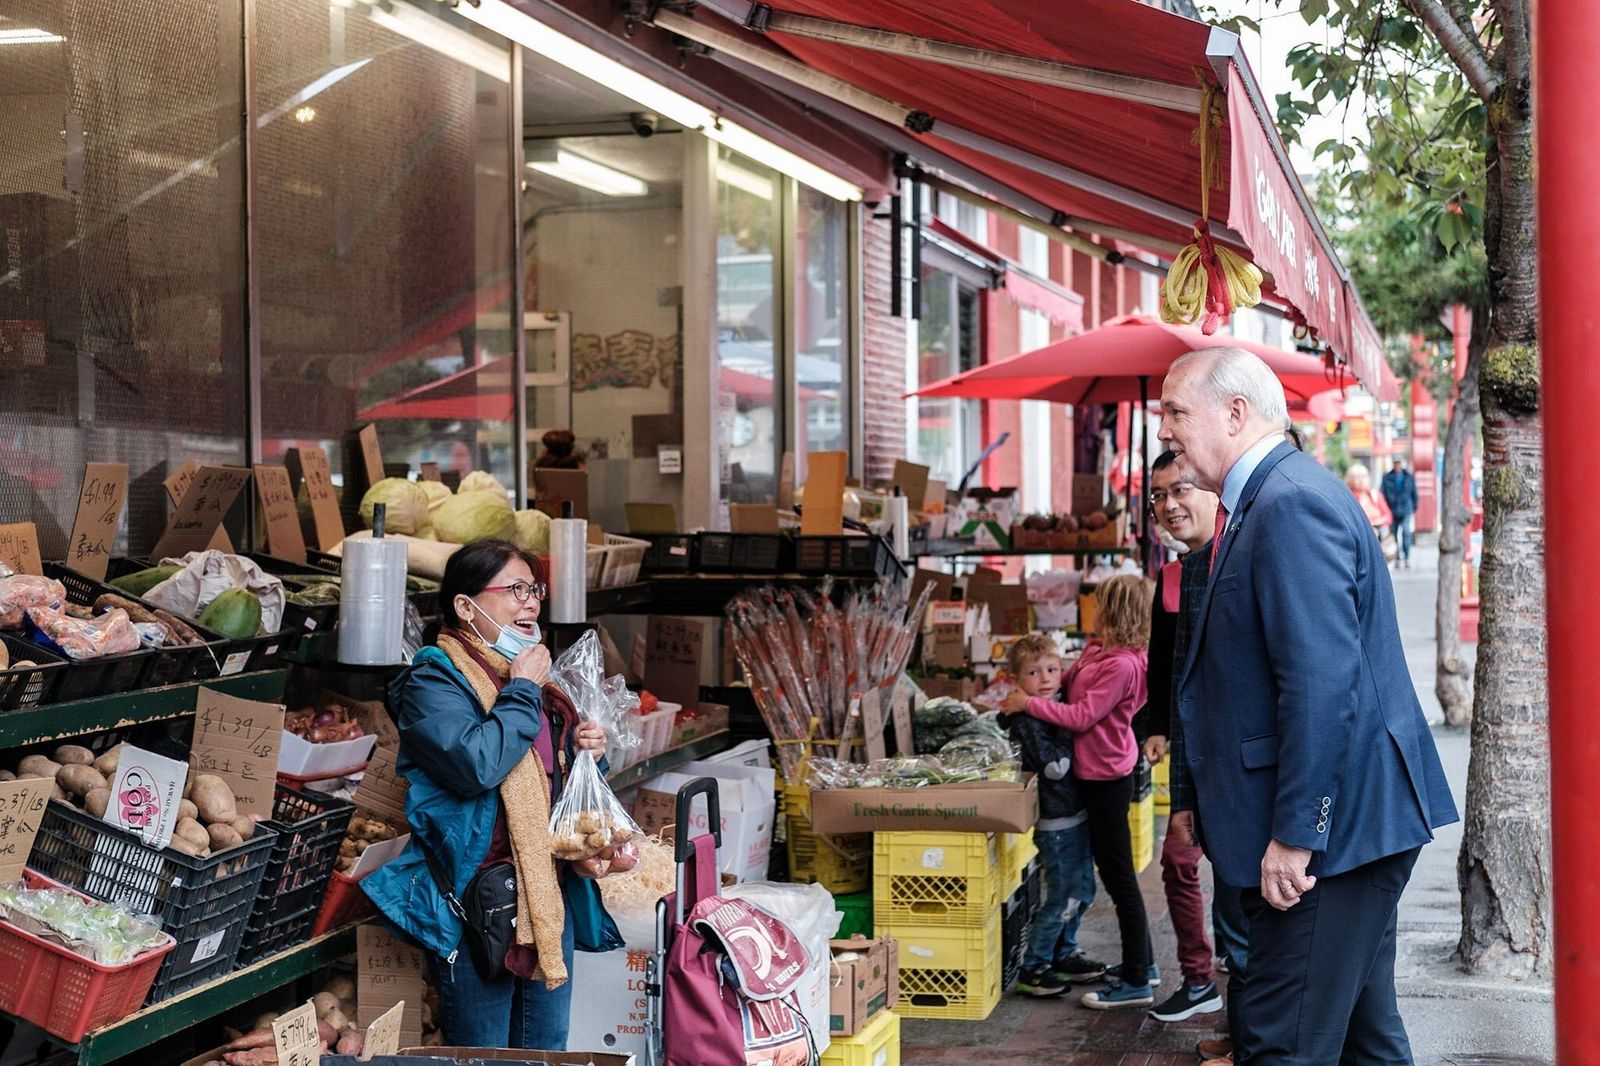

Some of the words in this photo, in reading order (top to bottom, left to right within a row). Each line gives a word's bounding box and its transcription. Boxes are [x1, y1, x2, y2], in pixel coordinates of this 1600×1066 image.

[854, 803, 890, 817] Fresh
[892, 803, 932, 817] Garlic
[935, 803, 979, 820] Sprout
[627, 979, 647, 992] LO
[617, 1025, 646, 1035] PROD
